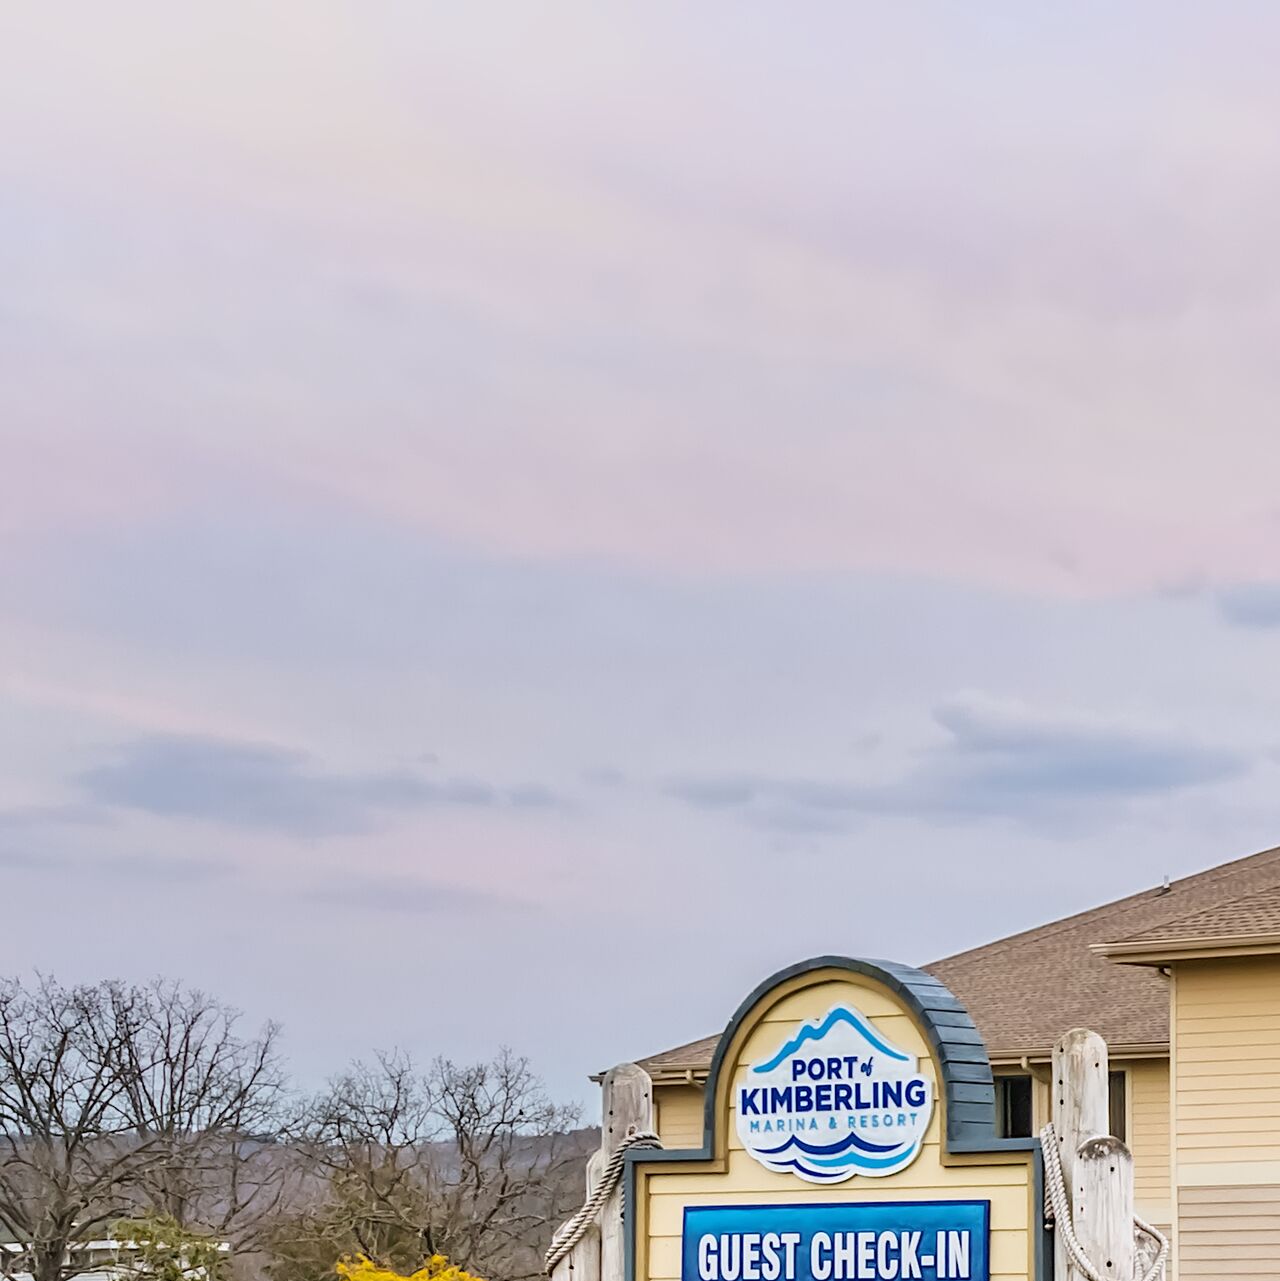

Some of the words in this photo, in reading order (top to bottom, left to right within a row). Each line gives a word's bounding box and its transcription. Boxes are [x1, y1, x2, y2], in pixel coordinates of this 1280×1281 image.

[792, 1056, 858, 1082] PORT
[860, 1056, 873, 1077] of
[741, 1079, 926, 1116] KIMBERLING
[750, 1117, 819, 1133] MARINA
[828, 1116, 838, 1130] &
[848, 1113, 918, 1129] RESORT
[698, 1232, 800, 1281] GUEST
[810, 1230, 970, 1280] CHECK-IN
